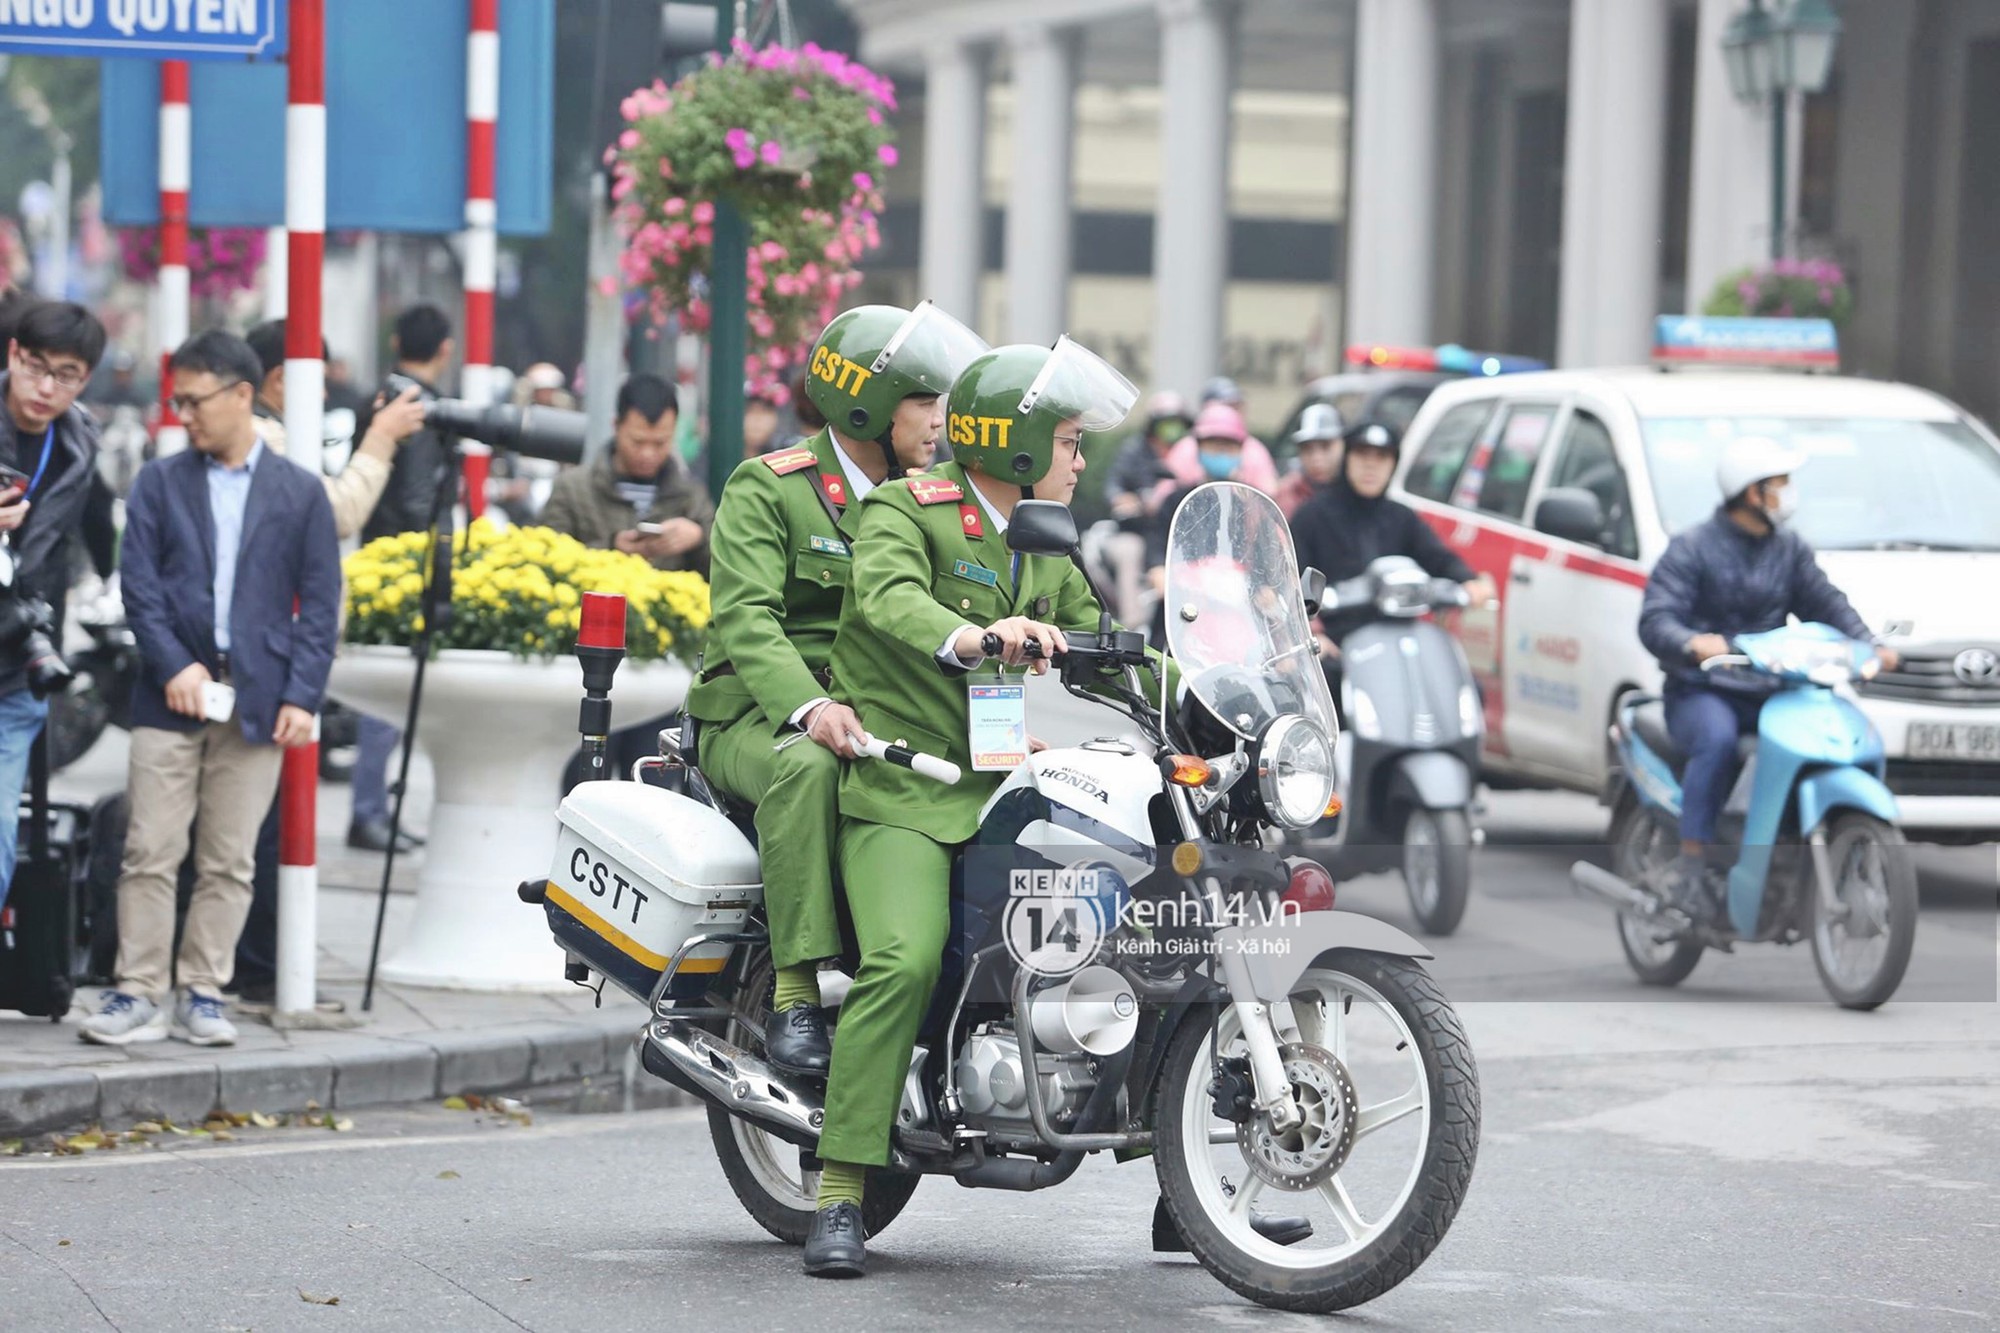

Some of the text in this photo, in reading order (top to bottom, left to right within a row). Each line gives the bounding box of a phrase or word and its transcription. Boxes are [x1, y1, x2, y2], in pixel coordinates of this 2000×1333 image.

[811, 346, 872, 397] CSTT
[950, 413, 1013, 448] CSTT
[978, 754, 1023, 766] SECURITY
[1040, 768, 1109, 804] HONDA
[570, 847, 649, 924] CSTT
